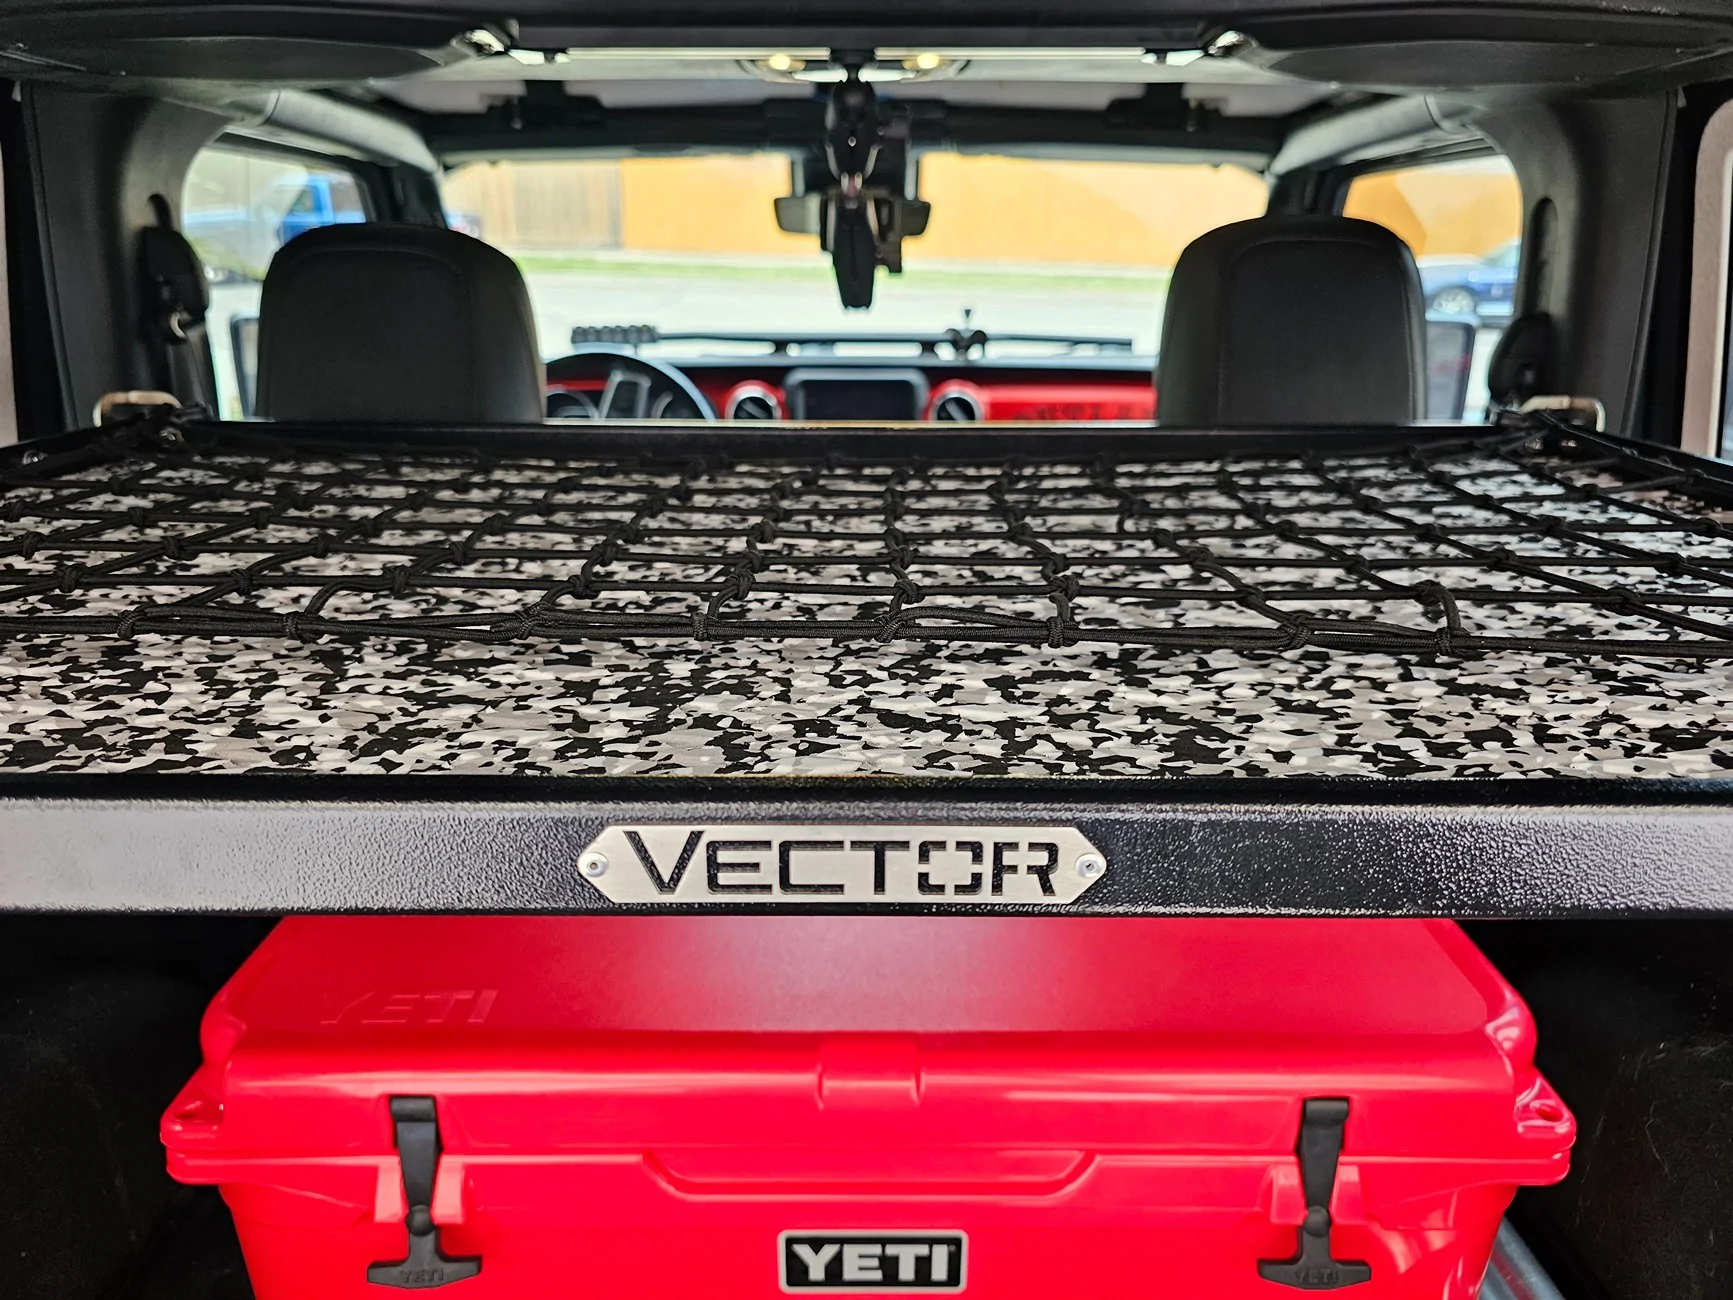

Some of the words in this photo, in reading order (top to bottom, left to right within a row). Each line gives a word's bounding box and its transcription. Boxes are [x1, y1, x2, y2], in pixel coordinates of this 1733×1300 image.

[622, 830, 1059, 897] VECTOR
[319, 989, 499, 1025] YETI
[400, 1267, 445, 1284] YETI
[791, 1243, 950, 1282] YETI
